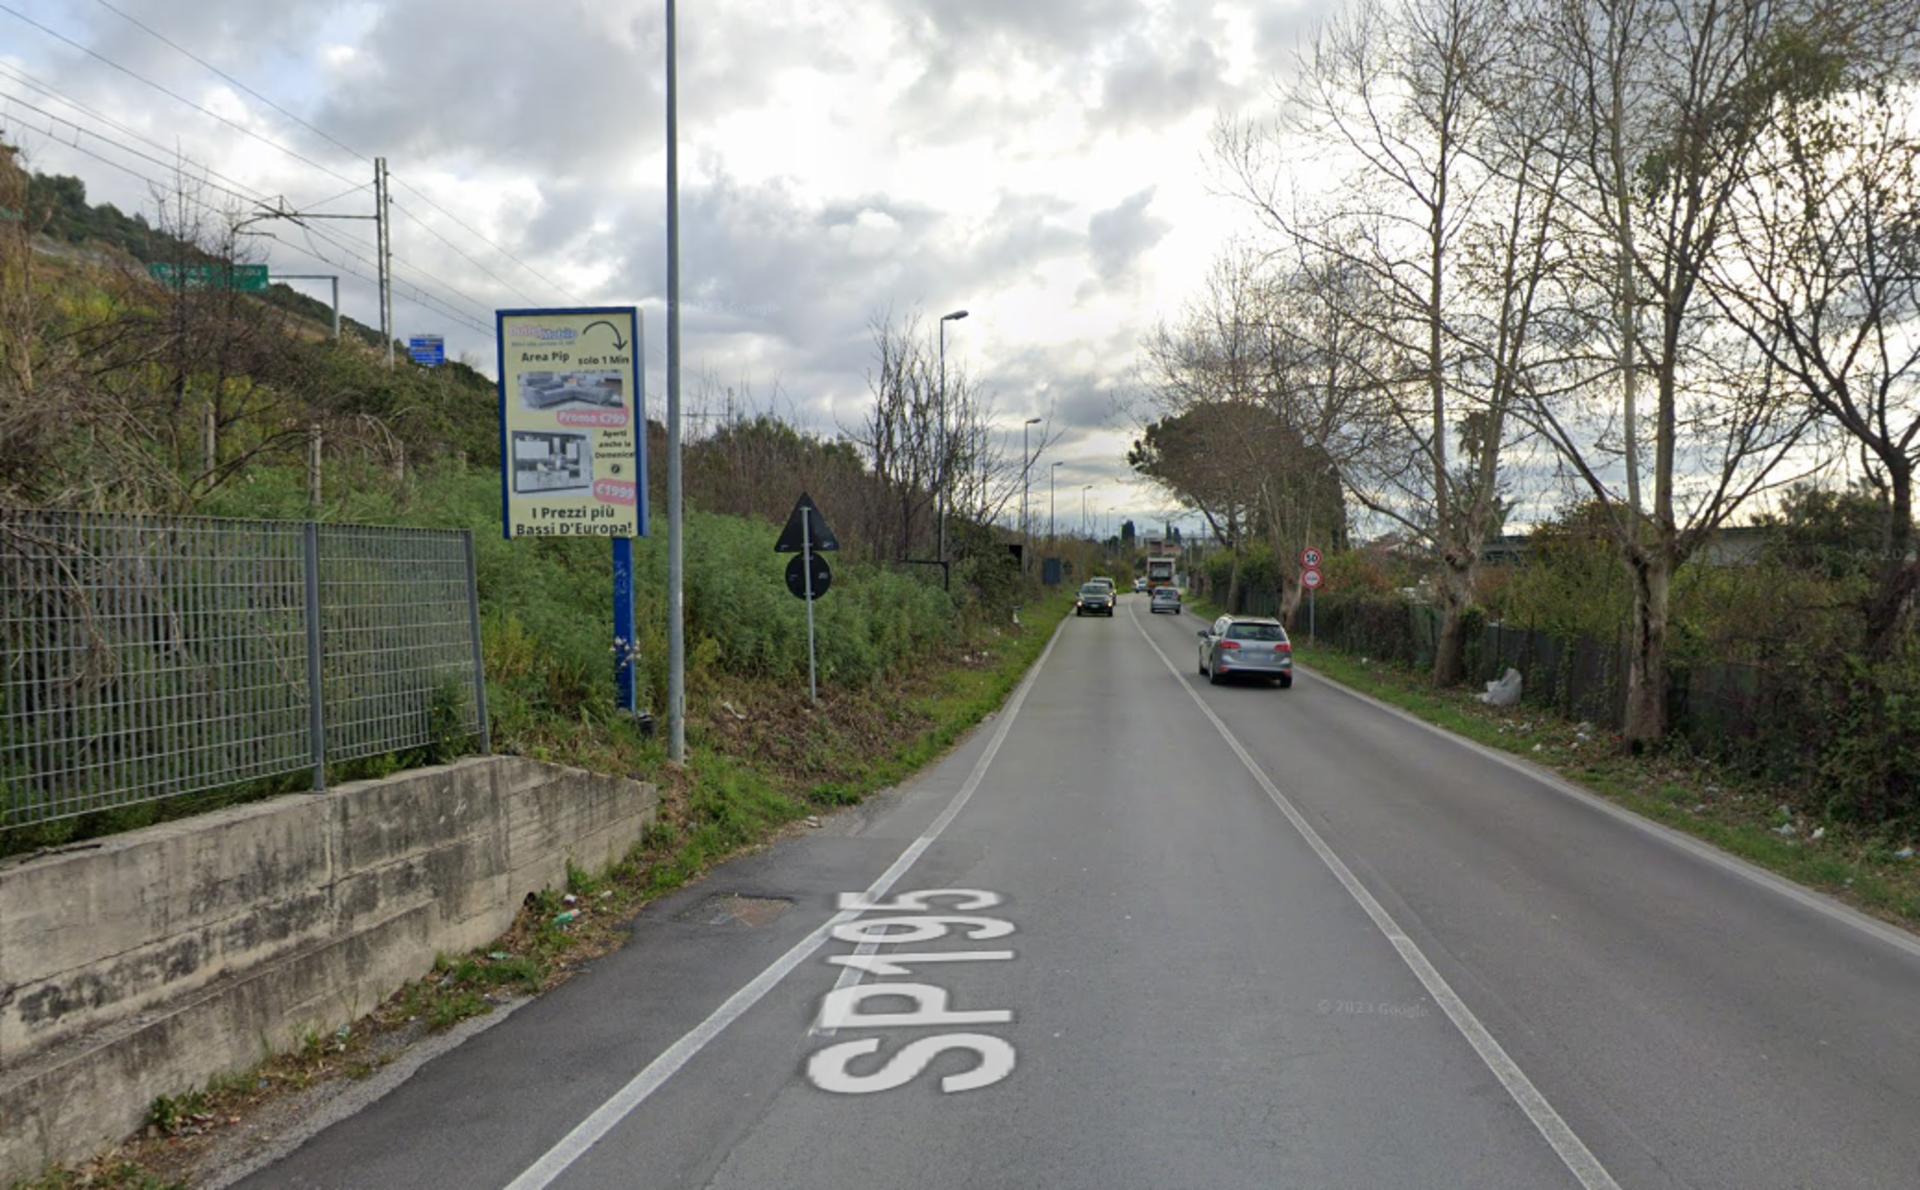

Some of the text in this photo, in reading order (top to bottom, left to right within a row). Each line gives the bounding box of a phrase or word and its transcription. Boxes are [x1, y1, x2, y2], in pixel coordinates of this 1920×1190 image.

[521, 351, 570, 363] Area Pip
[578, 356, 600, 365] solo
[610, 355, 630, 364] Min
[541, 506, 587, 519] Prezzi
[591, 504, 615, 521] più
[516, 522, 632, 535] Bassi D'Europa!
